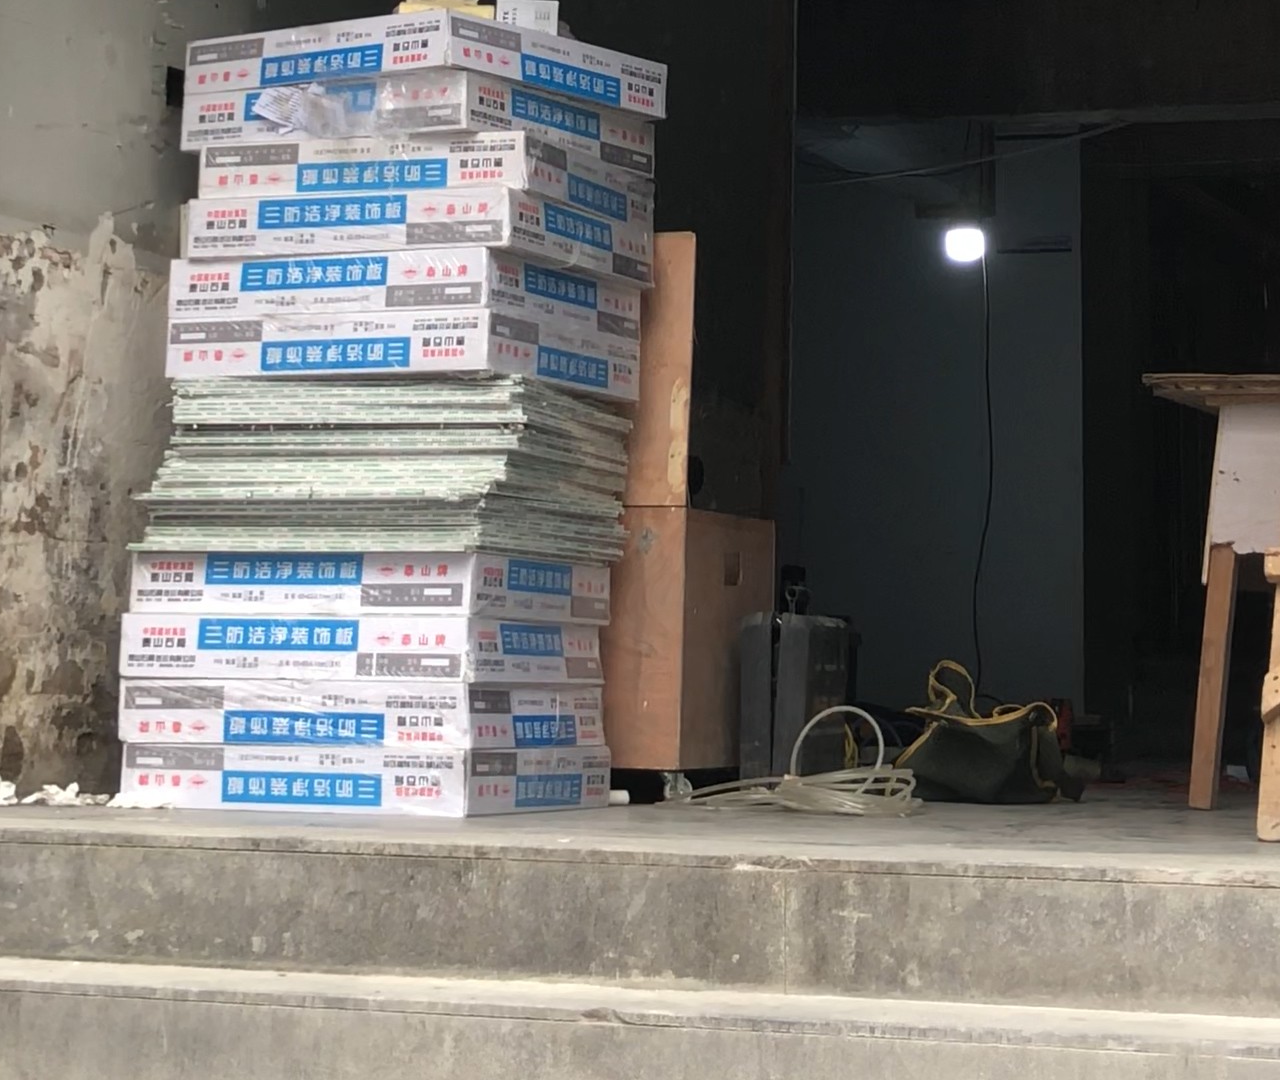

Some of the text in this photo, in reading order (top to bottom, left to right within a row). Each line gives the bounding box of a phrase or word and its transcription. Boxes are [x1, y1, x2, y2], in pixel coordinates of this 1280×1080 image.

[264, 201, 403, 224] 三防洁净装饰板
[246, 262, 384, 286] 三防洁净装饰板
[265, 342, 404, 364] 三防洁净装饰板
[212, 560, 358, 580] 三防洁净装饰板
[204, 625, 354, 646] 三防洁净装饰板
[229, 716, 378, 738] 三防洁净装饰板
[227, 774, 376, 799] 三防洁净装饰板
